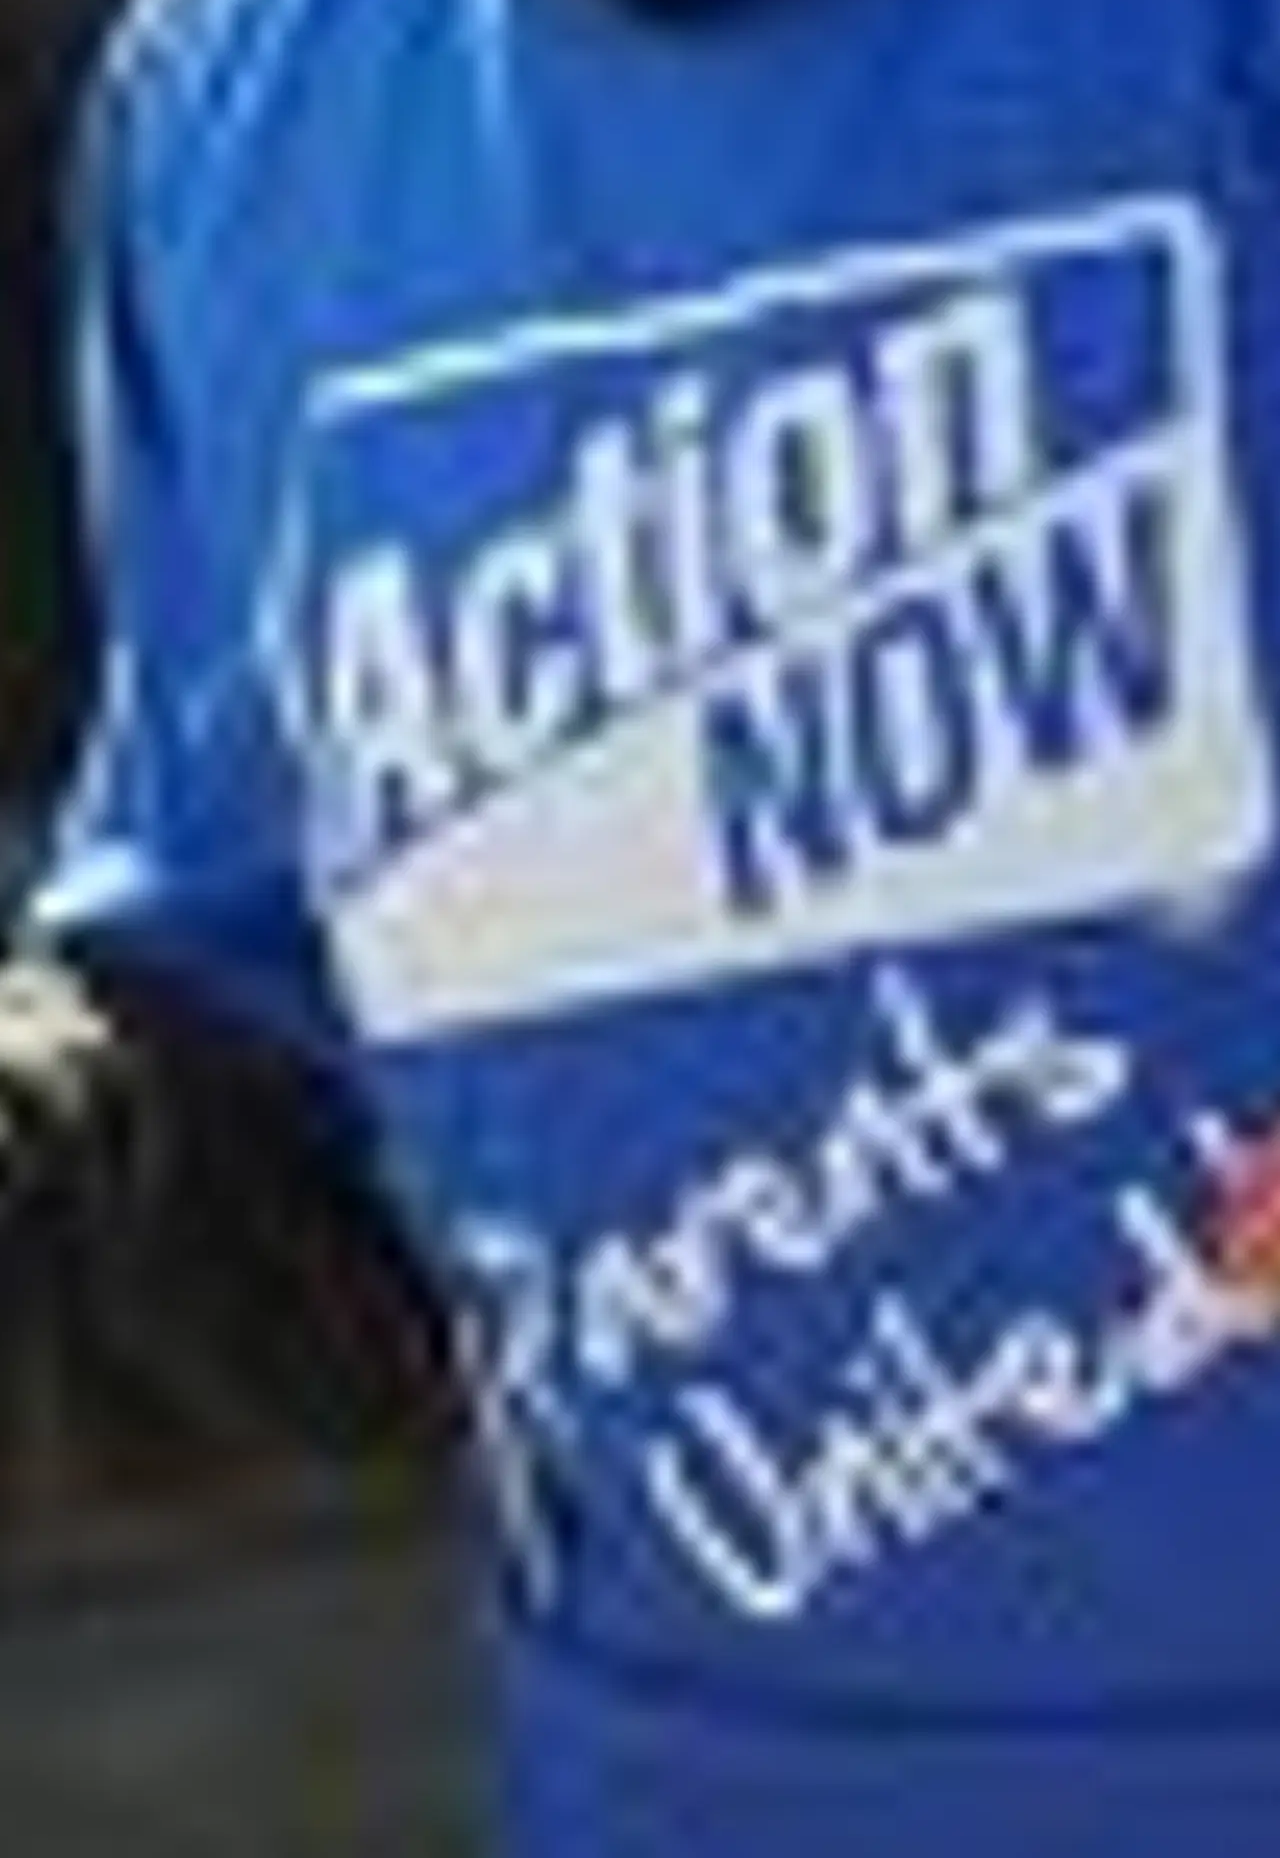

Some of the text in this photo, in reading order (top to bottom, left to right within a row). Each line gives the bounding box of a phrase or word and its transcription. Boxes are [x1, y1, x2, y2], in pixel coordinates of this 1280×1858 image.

[322, 288, 1042, 876] Action
[695, 488, 1172, 916] NOW
[455, 962, 1128, 1612] Parents
[646, 1182, 1265, 1620] United
